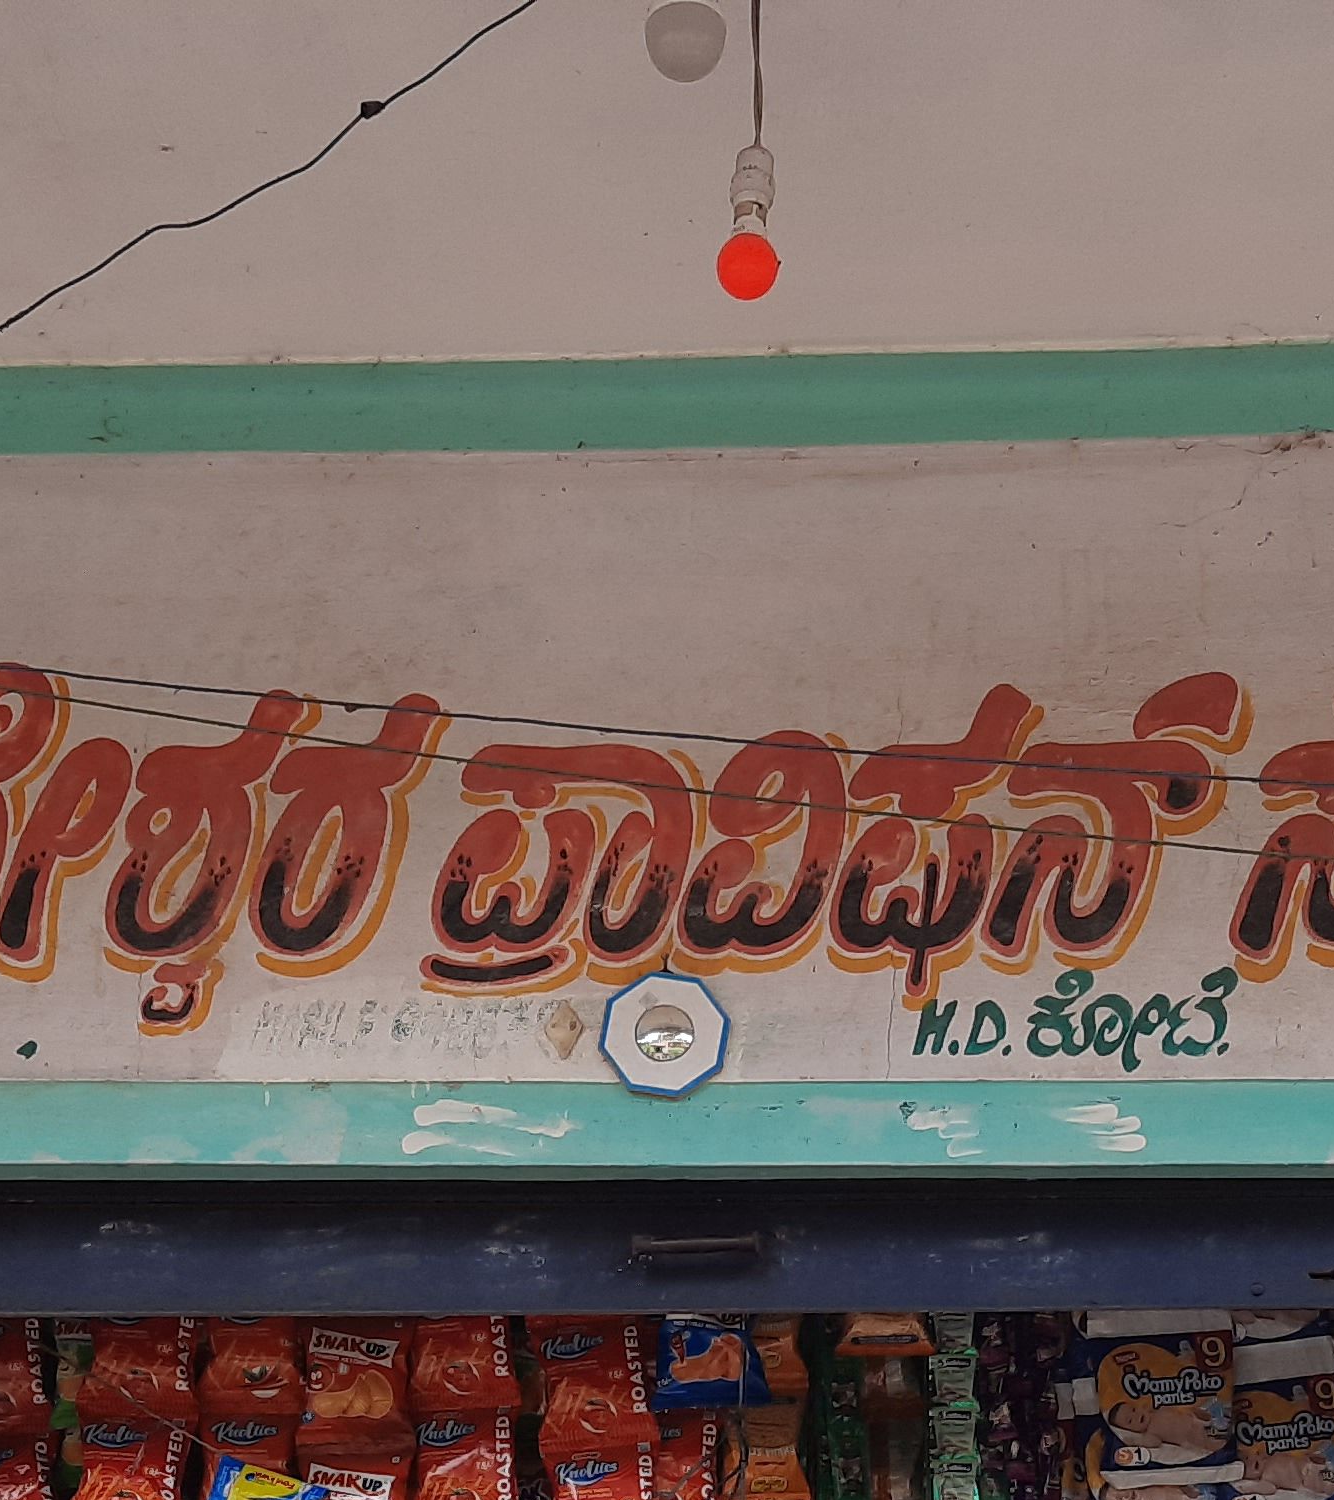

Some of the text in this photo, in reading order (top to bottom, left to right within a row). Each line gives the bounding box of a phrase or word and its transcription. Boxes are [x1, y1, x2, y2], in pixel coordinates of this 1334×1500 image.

[912, 999, 1012, 1056] H.D.
[175, 1317, 196, 1392] ROASTE
[490, 1316, 509, 1377] ROAST
[624, 1326, 648, 1413] ROASTED
[1153, 1391, 1194, 1407] pants
[1267, 1437, 1309, 1455] pants
